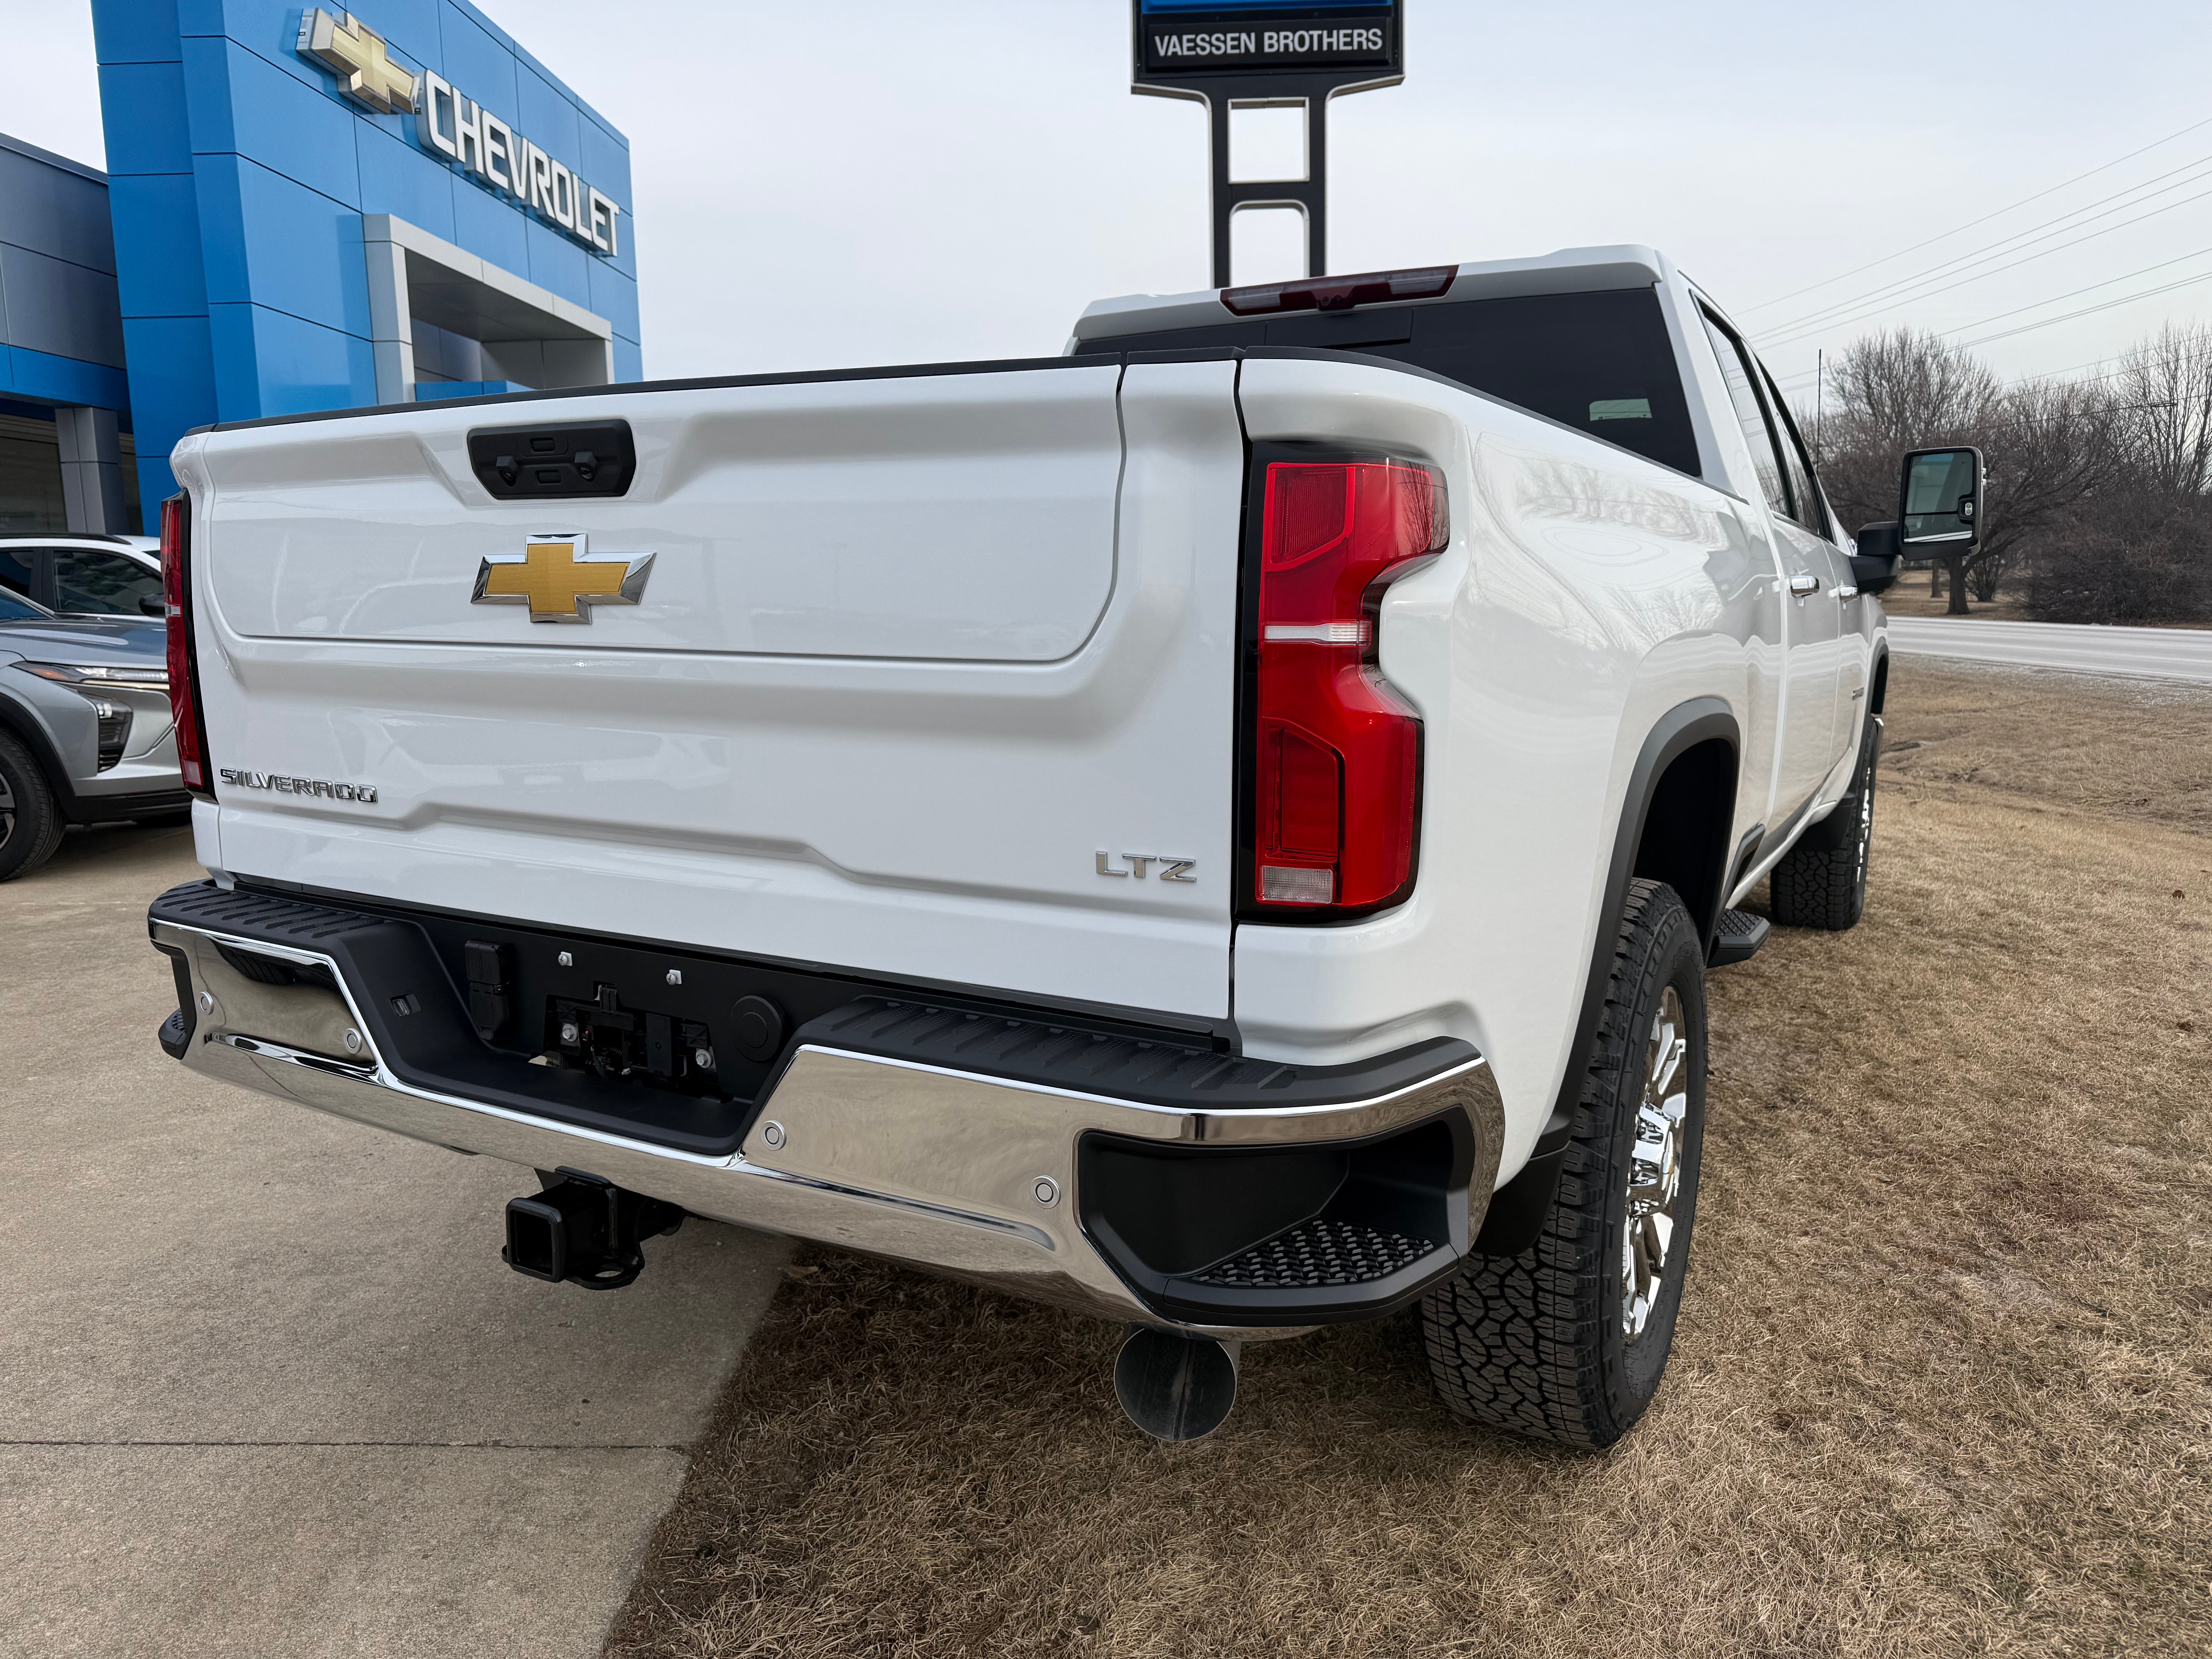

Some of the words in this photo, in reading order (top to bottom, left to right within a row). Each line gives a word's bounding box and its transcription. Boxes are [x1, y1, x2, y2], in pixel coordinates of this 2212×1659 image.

[1154, 32, 1256, 57] VAESSEN
[1263, 28, 1383, 53] BROTHERS
[425, 69, 620, 258] CHEVROLET
[220, 767, 378, 803] SILVERADO
[1095, 851, 1197, 883] LTZ
